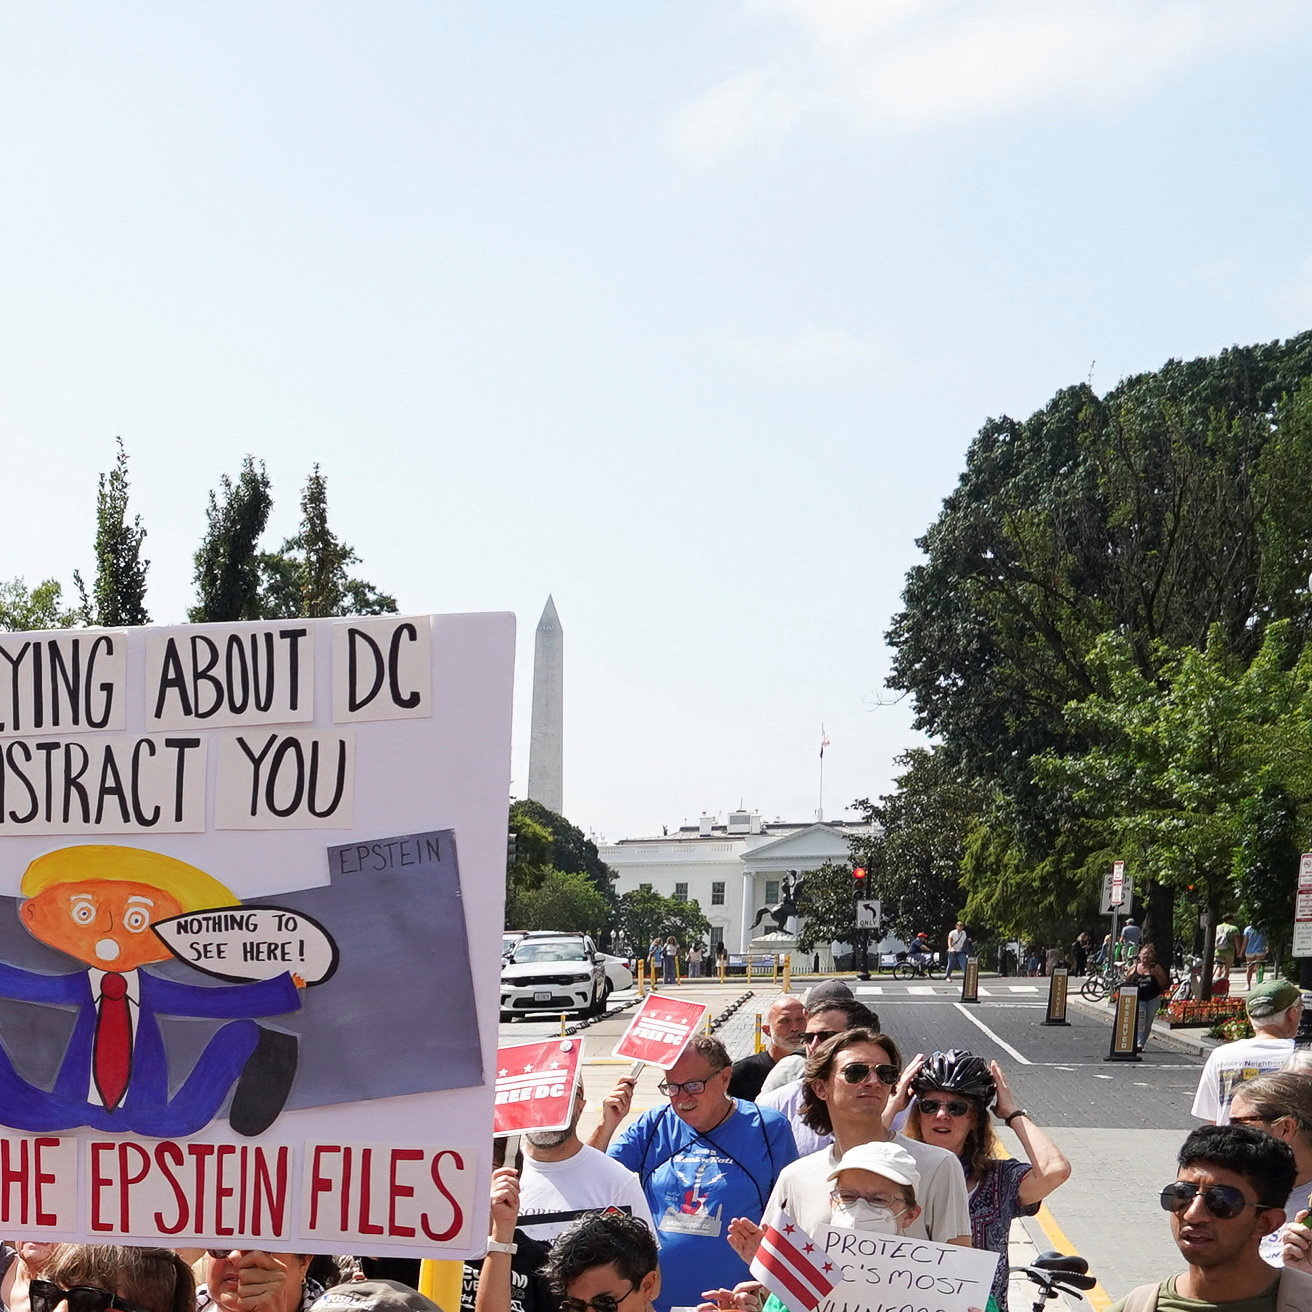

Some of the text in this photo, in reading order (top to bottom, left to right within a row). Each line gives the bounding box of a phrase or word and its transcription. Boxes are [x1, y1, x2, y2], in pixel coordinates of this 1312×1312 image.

[155, 627, 307, 719] ABOUT
[347, 623, 421, 713] DC
[234, 735, 346, 819] YOU
[339, 838, 442, 875] EPSTEIN
[176, 914, 298, 935] NOTHING TO
[190, 938, 305, 962] SEE HERE!
[631, 1026, 684, 1046] FREE DC
[1121, 997, 1131, 1049] RESERVED
[495, 1083, 565, 1105] REE DC
[89, 1144, 289, 1238] EPSTEIN
[309, 1144, 465, 1240] FILES
[825, 1231, 957, 1265] PROTECT
[841, 1264, 979, 1294] C'S MOST
